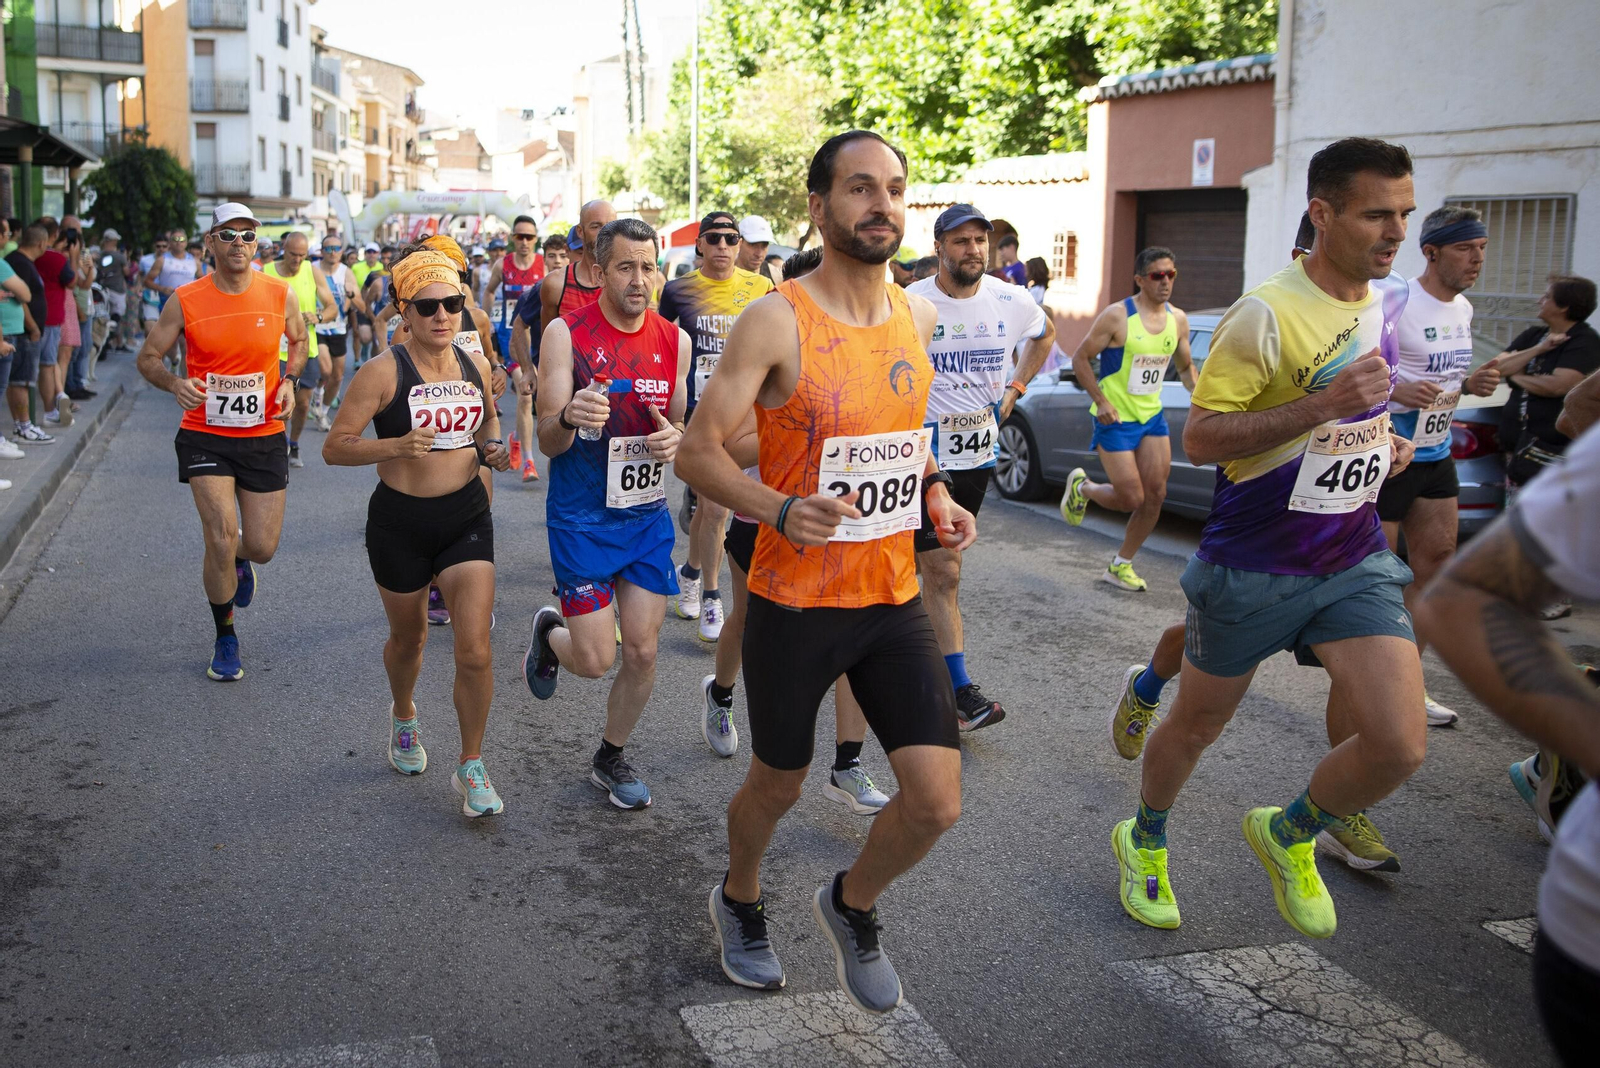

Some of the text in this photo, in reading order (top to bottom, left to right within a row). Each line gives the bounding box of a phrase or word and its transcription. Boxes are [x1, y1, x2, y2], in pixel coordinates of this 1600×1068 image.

[696, 335, 727, 353] ALHE
[931, 350, 969, 374] XXXVI
[219, 379, 256, 389] FONDO
[634, 378, 669, 394] SEUR
[1141, 369, 1160, 385] 90
[424, 385, 469, 399] FONDO
[216, 394, 258, 415] 748
[415, 406, 482, 434] 2027
[953, 413, 987, 427] FONDO
[1425, 410, 1453, 434] 660
[948, 429, 991, 455] 344
[1336, 426, 1377, 447] FONDO
[849, 442, 914, 463] FONDO
[621, 462, 664, 491] 685
[1314, 453, 1381, 493] 466
[576, 583, 594, 593] SEUR
